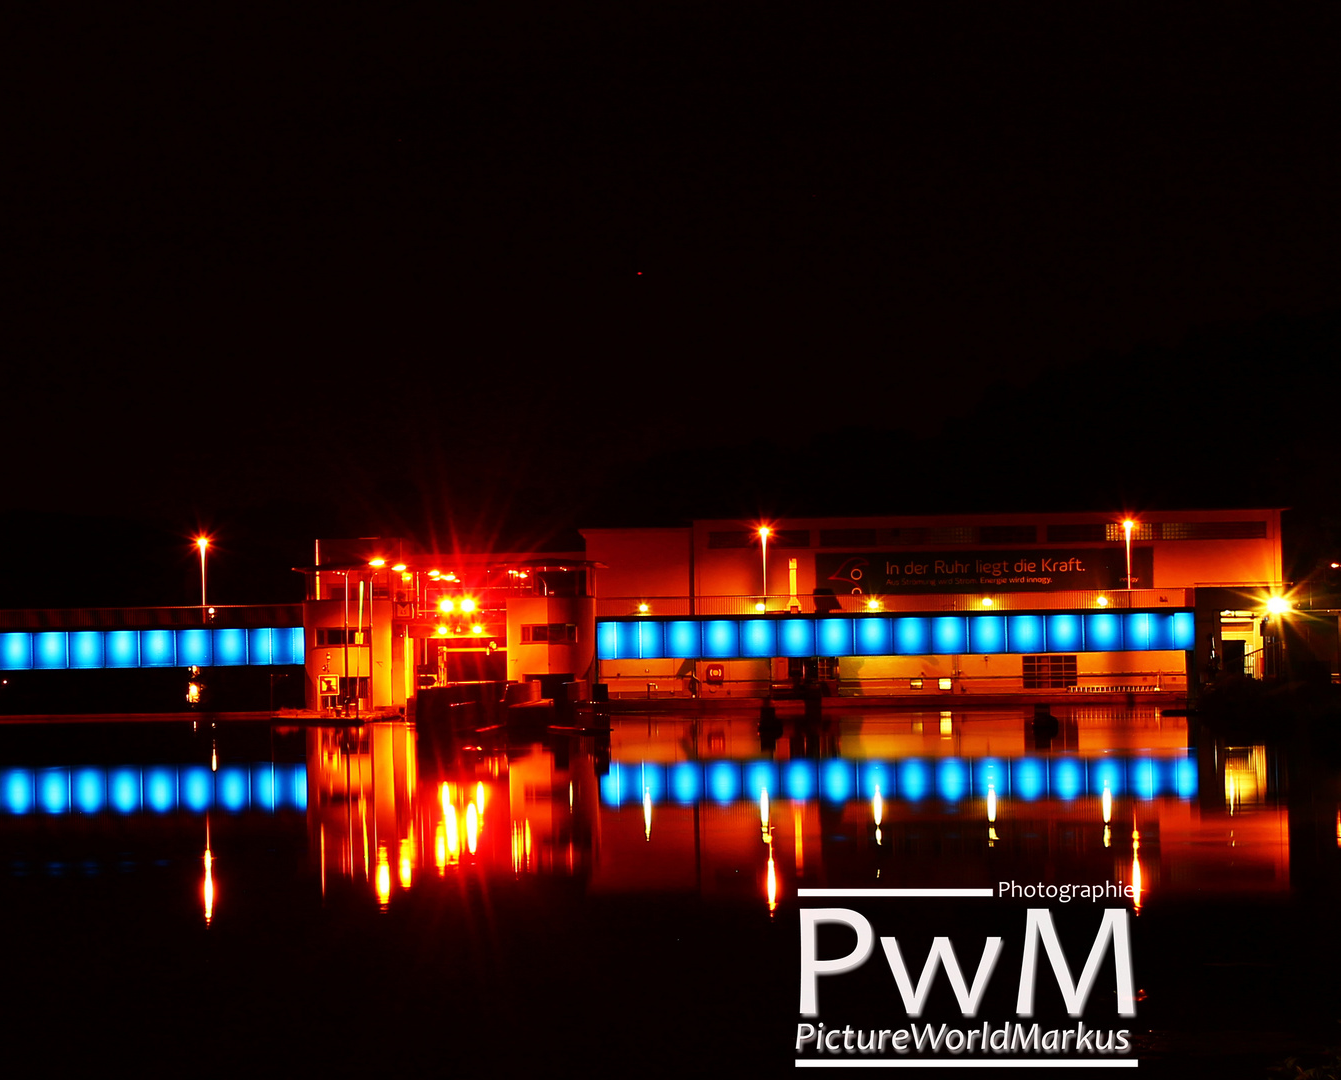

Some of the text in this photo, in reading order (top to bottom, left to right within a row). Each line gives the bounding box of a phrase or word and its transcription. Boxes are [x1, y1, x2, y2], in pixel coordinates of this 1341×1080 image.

[886, 557, 1086, 576] In der Ruhr liegt die Kraft.
[980, 576, 1007, 585] Energie
[1009, 576, 1025, 584] wird
[1027, 576, 1052, 585] innogy.
